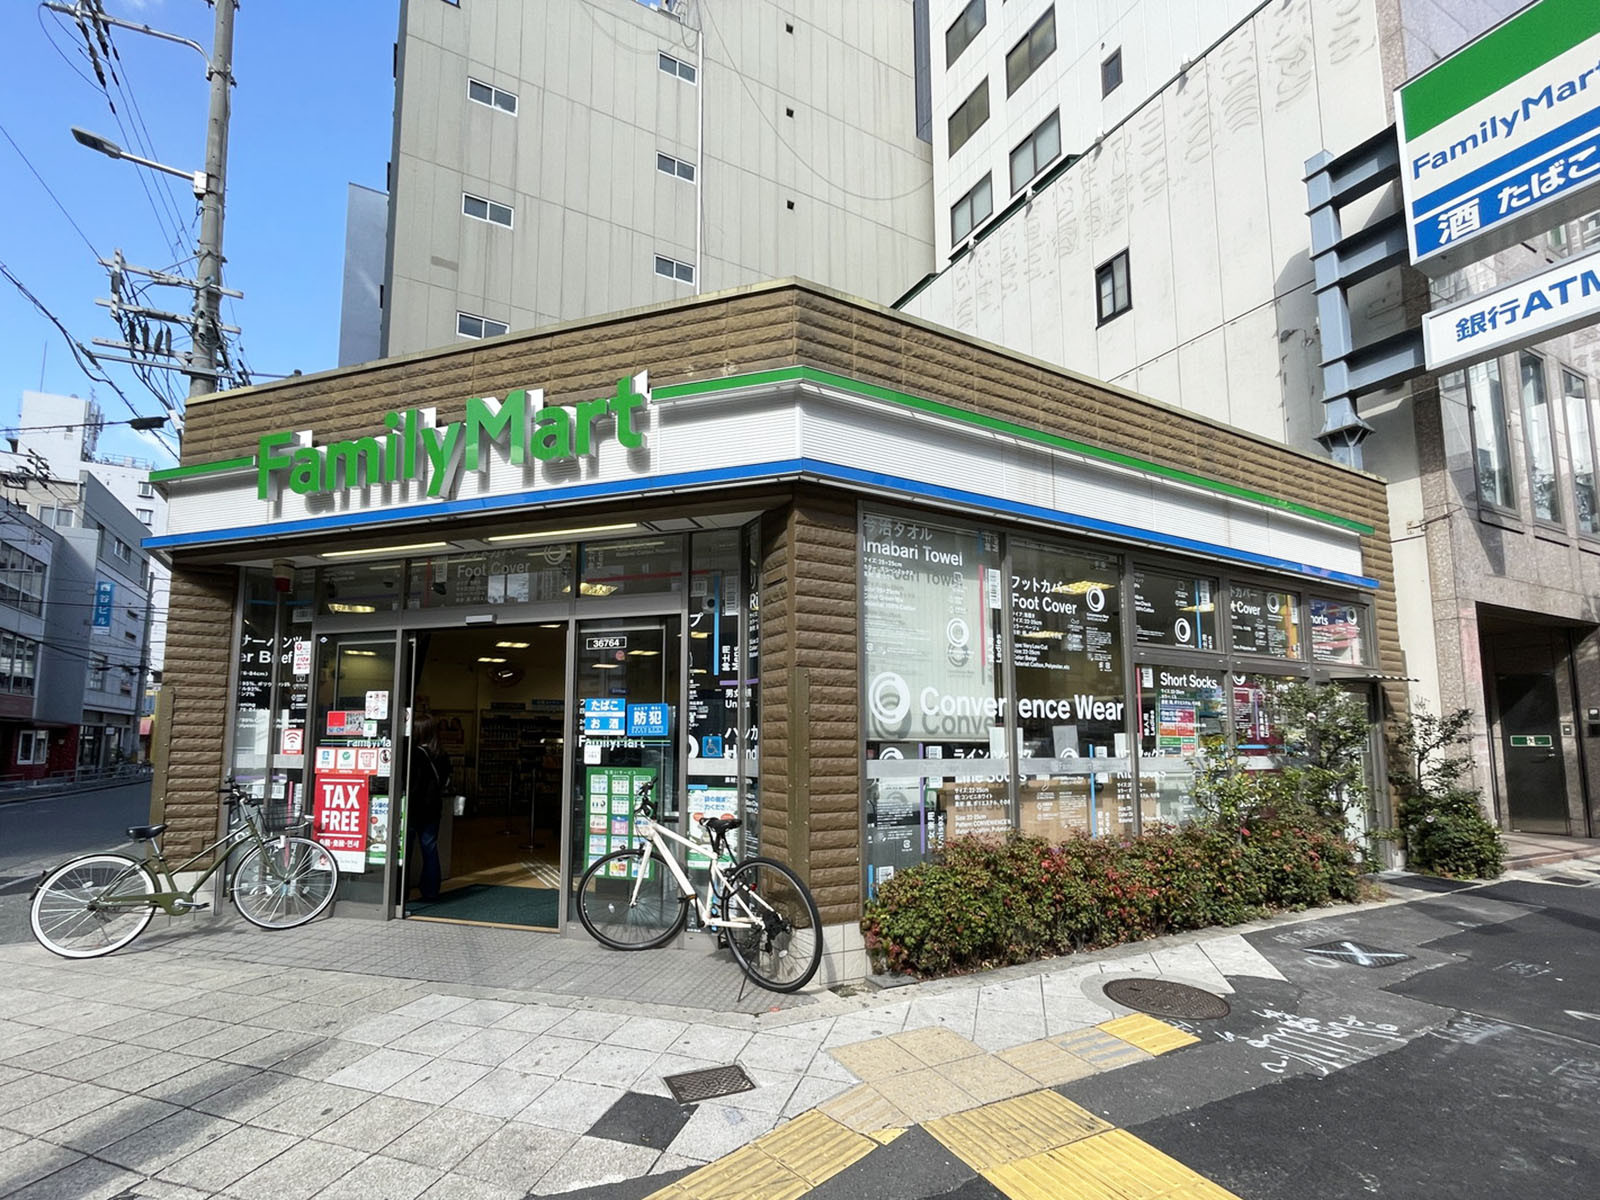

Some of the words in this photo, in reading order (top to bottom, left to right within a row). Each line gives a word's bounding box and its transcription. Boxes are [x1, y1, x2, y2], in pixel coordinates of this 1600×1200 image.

[1438, 197, 1481, 244] 酒
[1497, 145, 1600, 214] たばこ
[257, 373, 648, 501] FamilyMart
[863, 535, 918, 560] Imabari
[923, 545, 963, 566] Towel
[457, 563, 487, 578] Foot
[490, 561, 530, 575] Cover
[1012, 593, 1040, 611] Foot
[1042, 596, 1077, 614] Cover
[1237, 601, 1260, 615] Cover
[593, 639, 620, 648] 36764
[1160, 672, 1187, 687] Short
[1189, 674, 1218, 689] Socks
[591, 700, 619, 711] たばこ
[920, 686, 1071, 719] Conveence
[1074, 694, 1124, 721] Wear
[633, 710, 662, 725] 防犯
[322, 784, 360, 809] TAX
[321, 810, 360, 832] FREE
